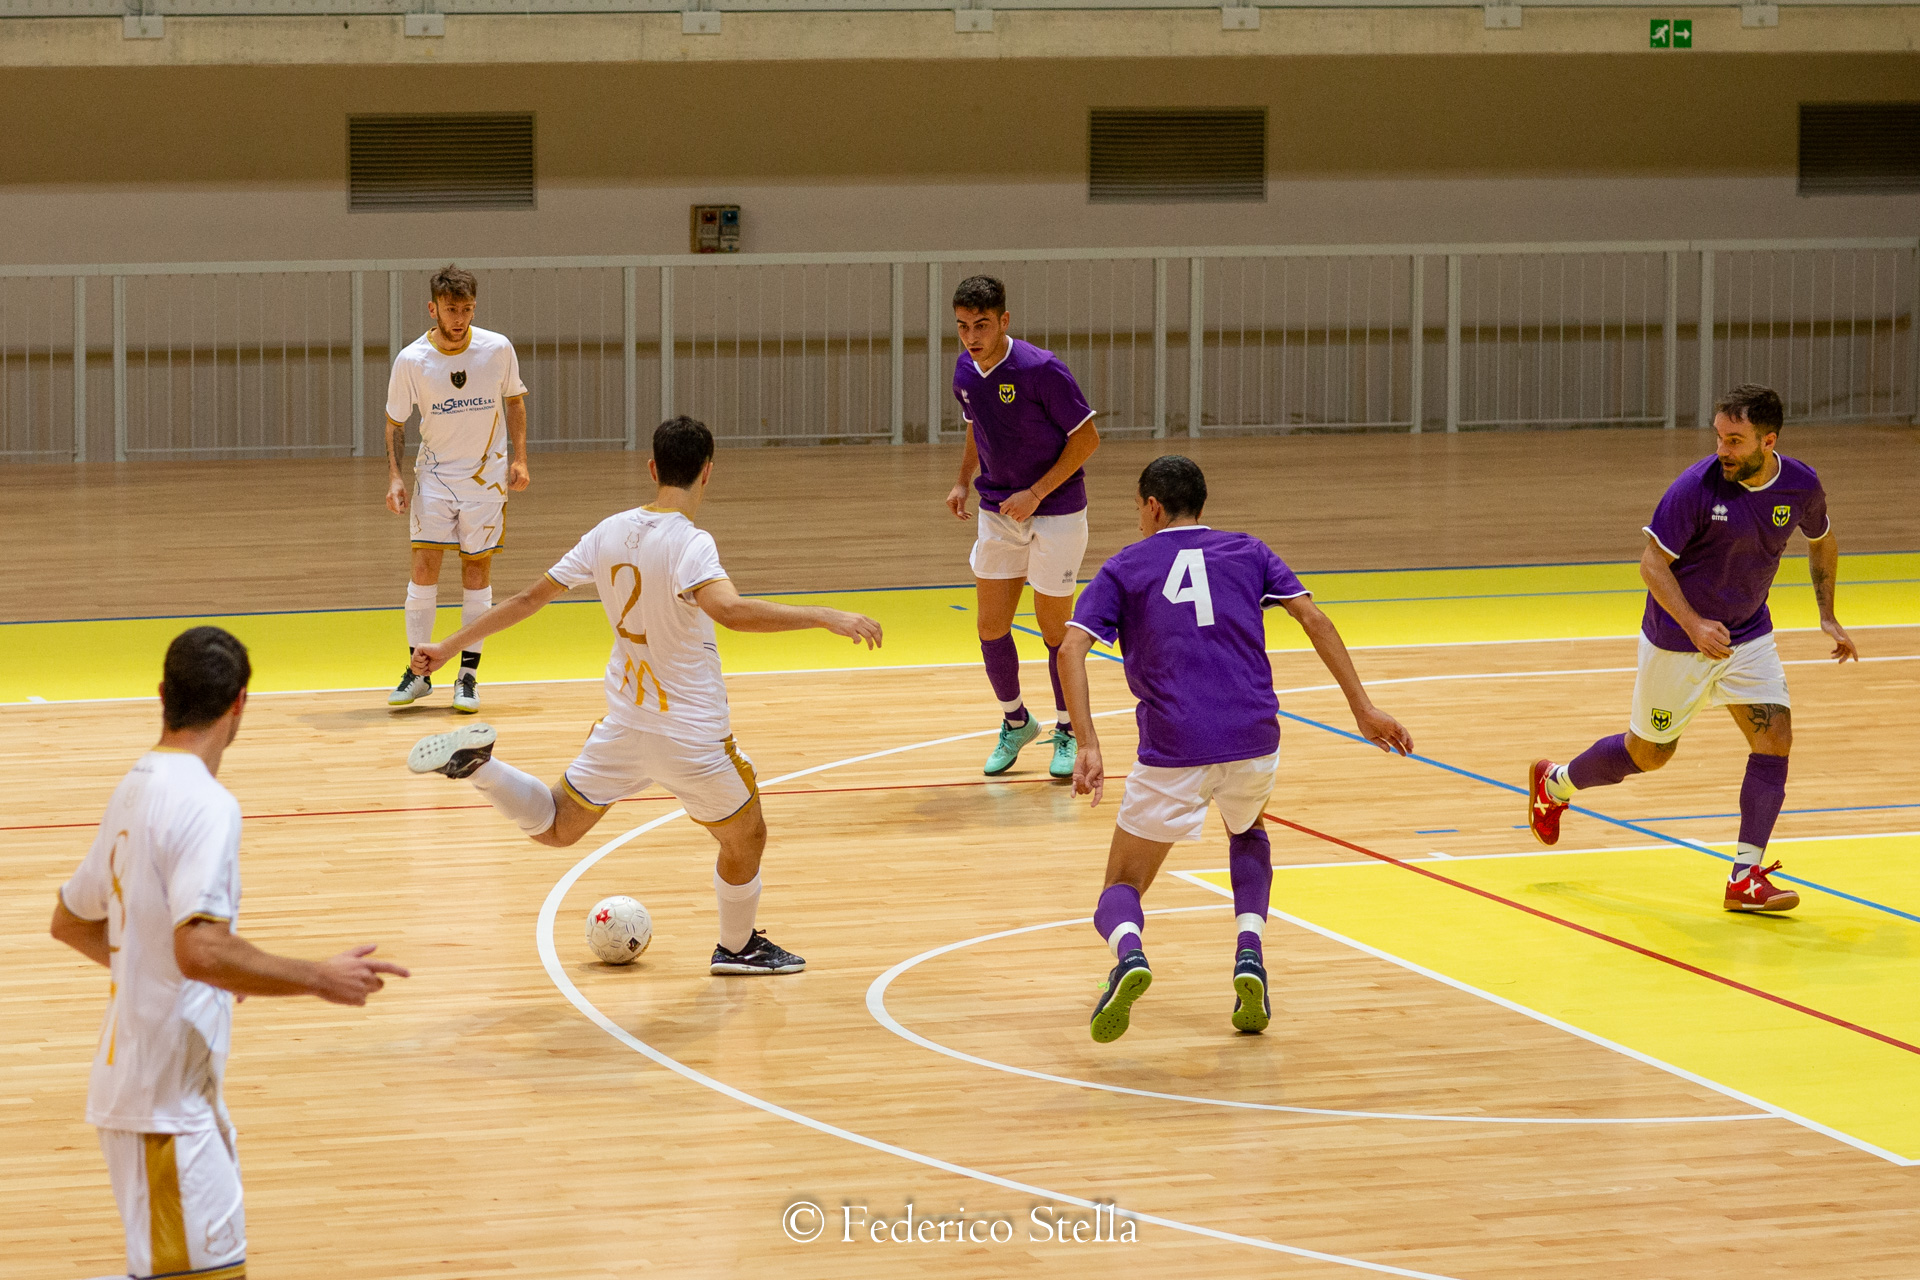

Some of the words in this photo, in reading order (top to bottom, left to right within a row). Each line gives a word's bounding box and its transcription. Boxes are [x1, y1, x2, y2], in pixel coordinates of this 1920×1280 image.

[483, 525, 496, 546] 7
[611, 563, 649, 647] 2
[1162, 548, 1215, 627] 4
